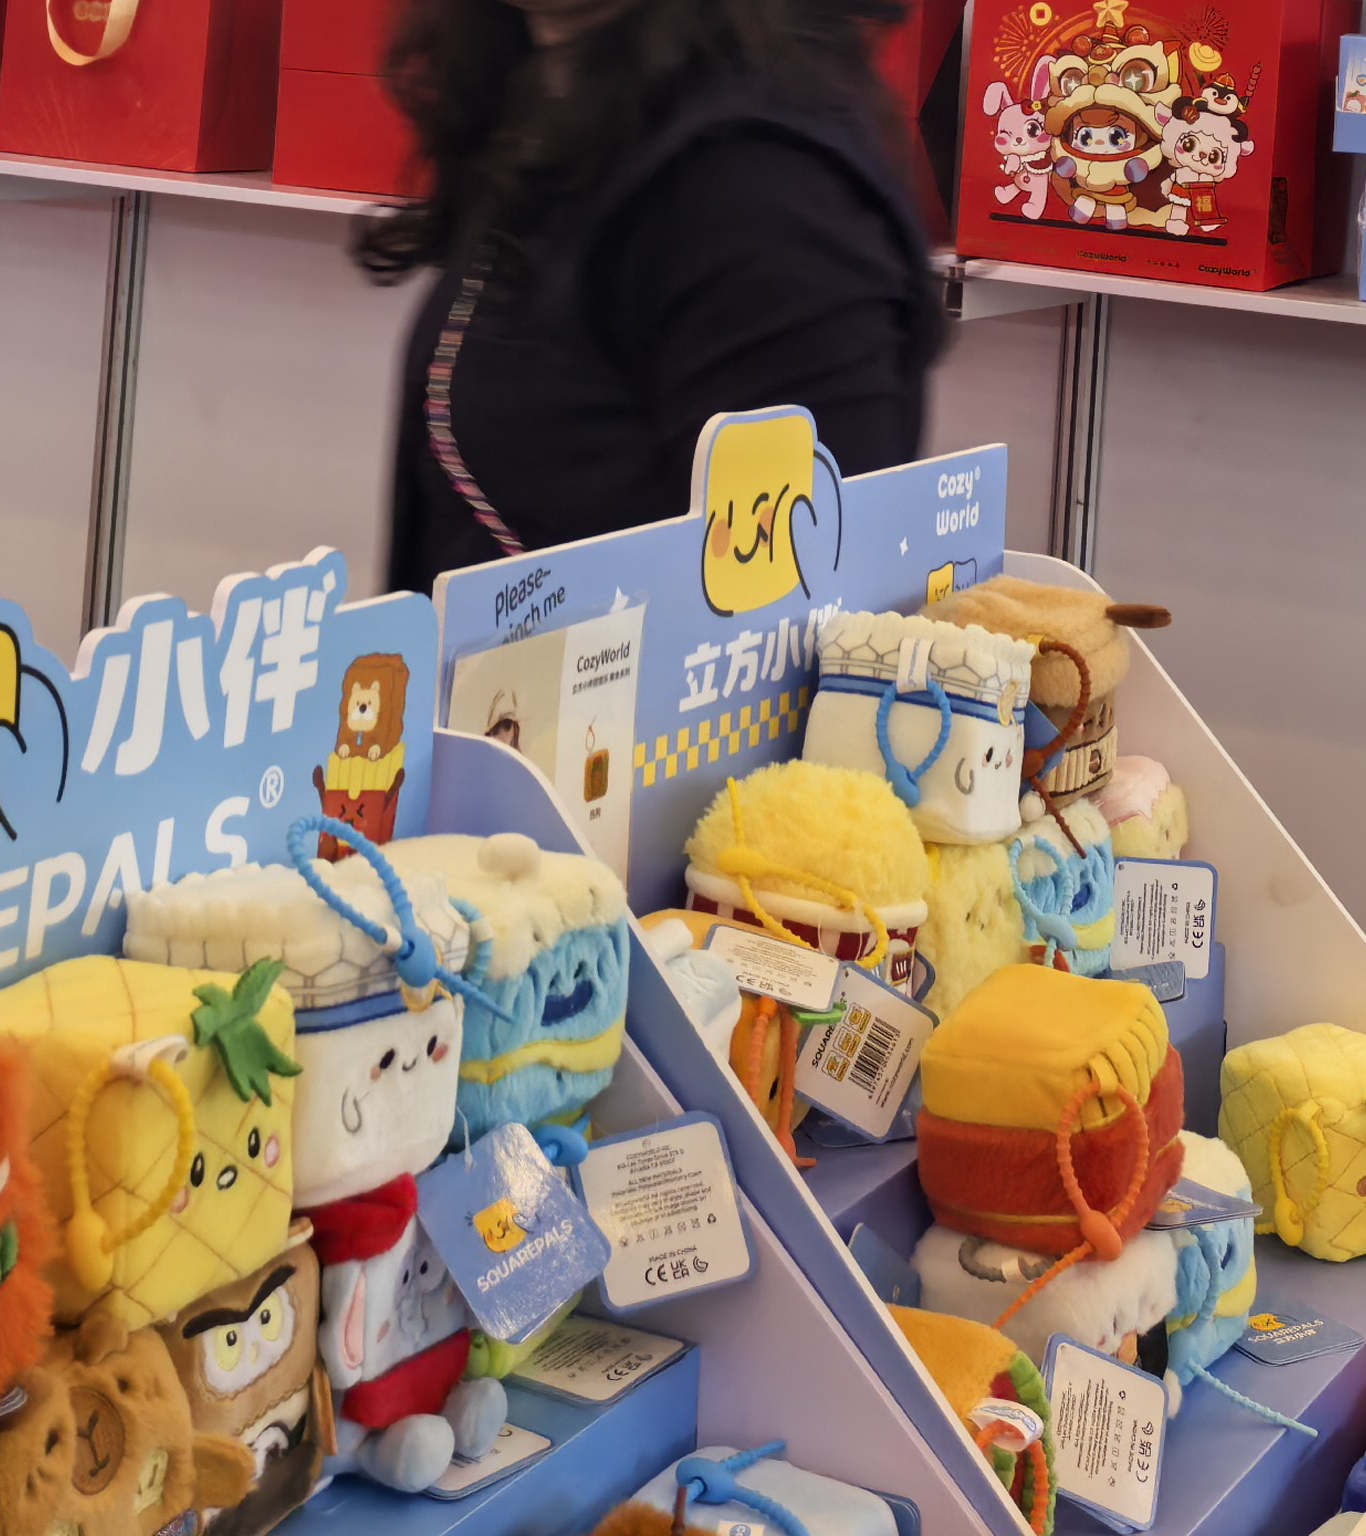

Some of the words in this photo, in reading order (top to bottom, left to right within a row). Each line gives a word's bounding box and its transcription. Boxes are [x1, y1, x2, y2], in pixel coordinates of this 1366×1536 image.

[936, 501, 980, 536] World
[543, 586, 566, 618] me
[80, 569, 336, 776] 小伴
[577, 641, 631, 673] CozyWorld
[477, 1219, 574, 1293] SQUAREPALS
